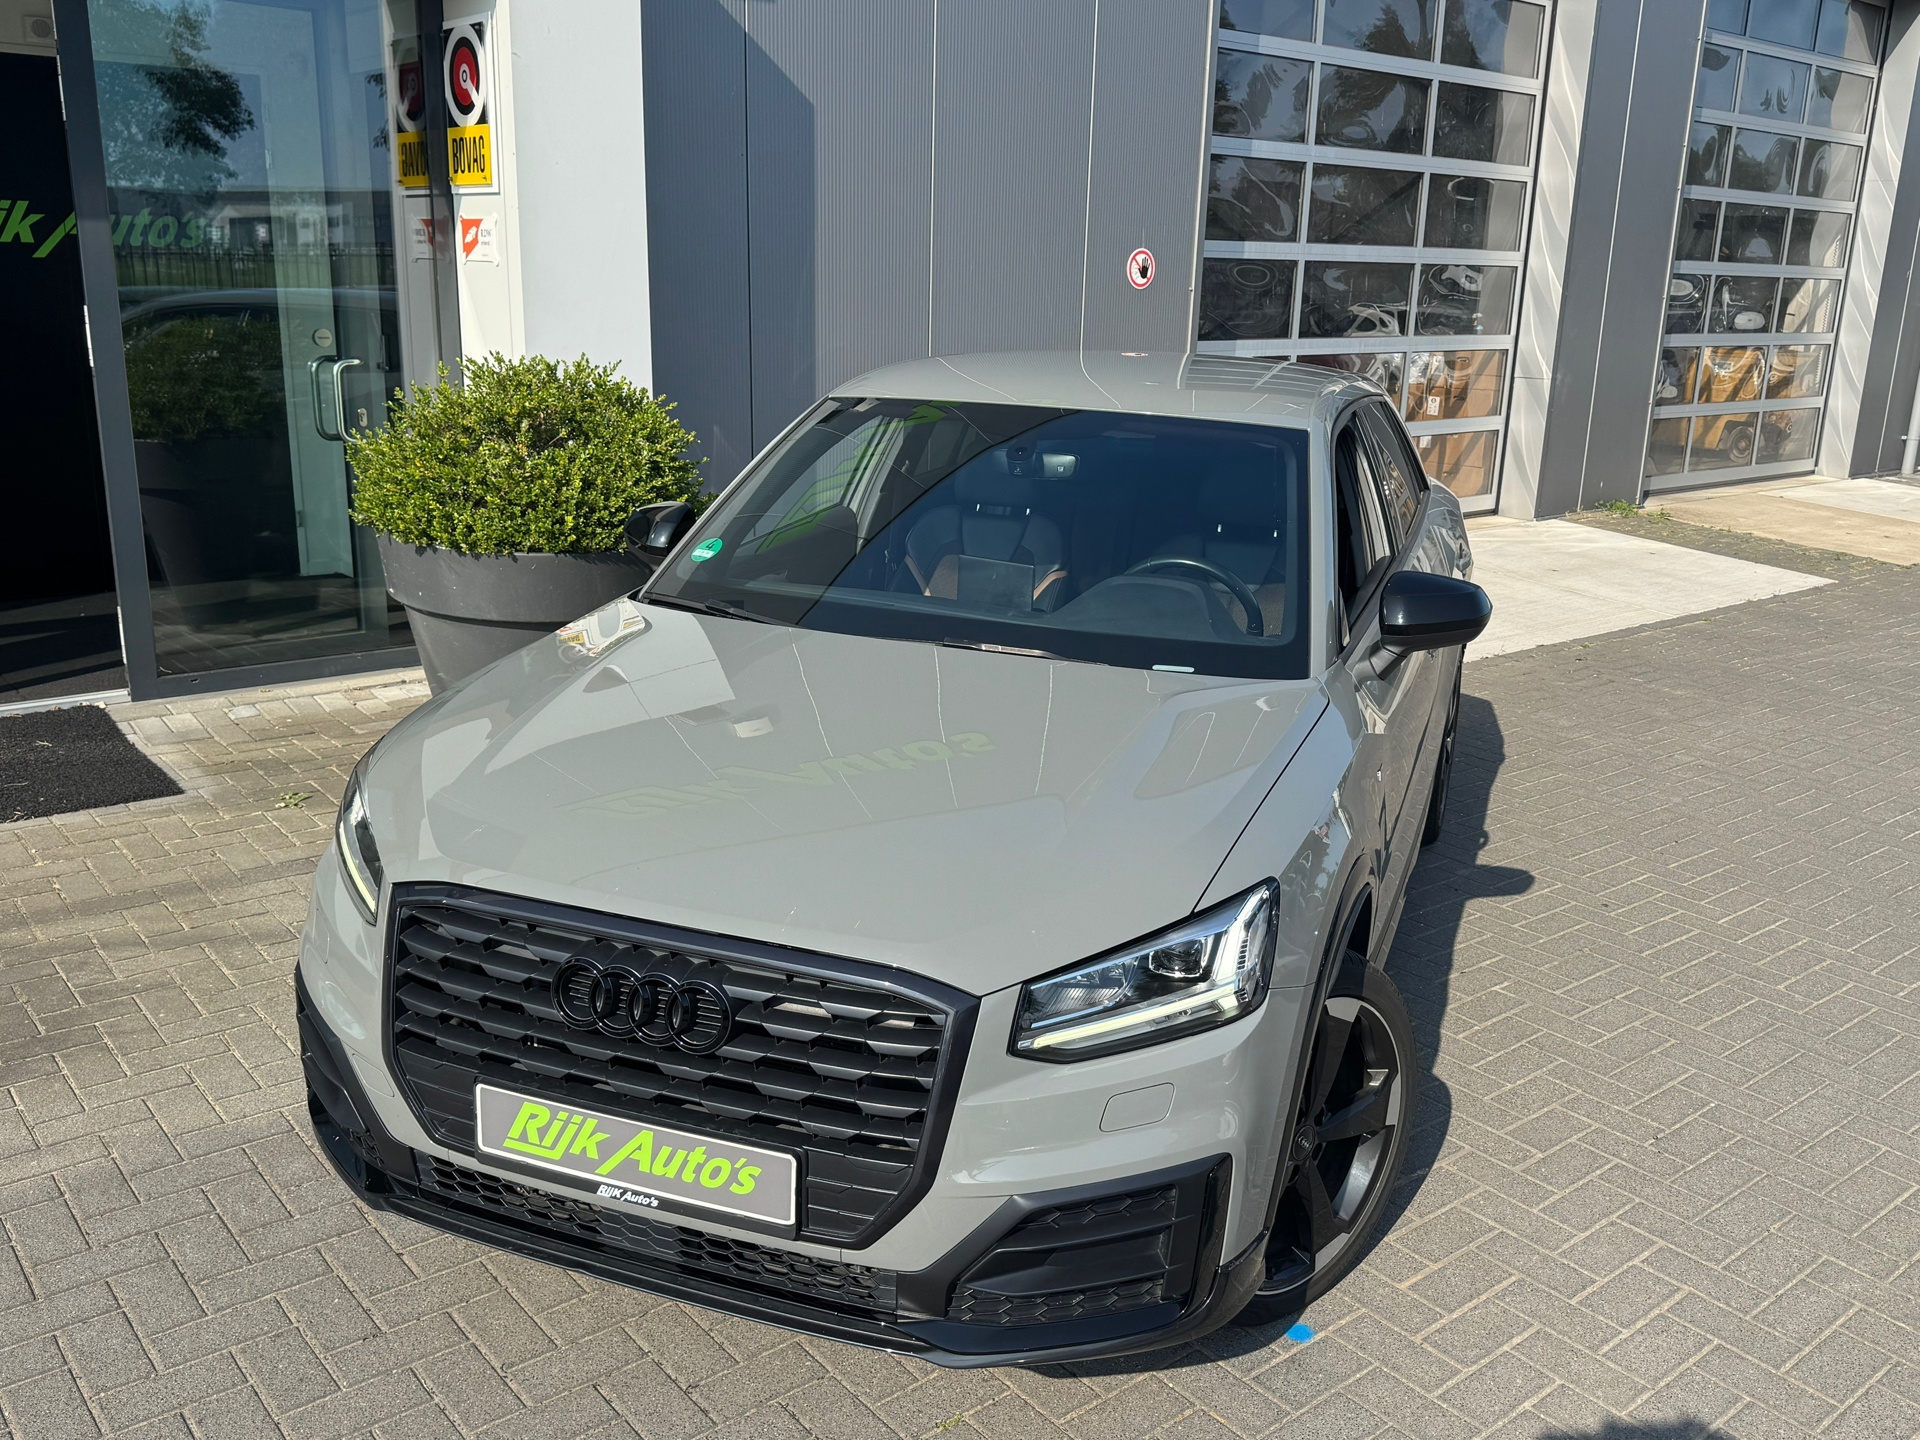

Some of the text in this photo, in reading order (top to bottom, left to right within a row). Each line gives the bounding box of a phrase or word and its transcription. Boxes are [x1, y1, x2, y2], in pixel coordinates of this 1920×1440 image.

[452, 135, 485, 174] BOVAG
[503, 1101, 762, 1194] Rijk Auto's
[620, 1191, 659, 1207] Auto's
